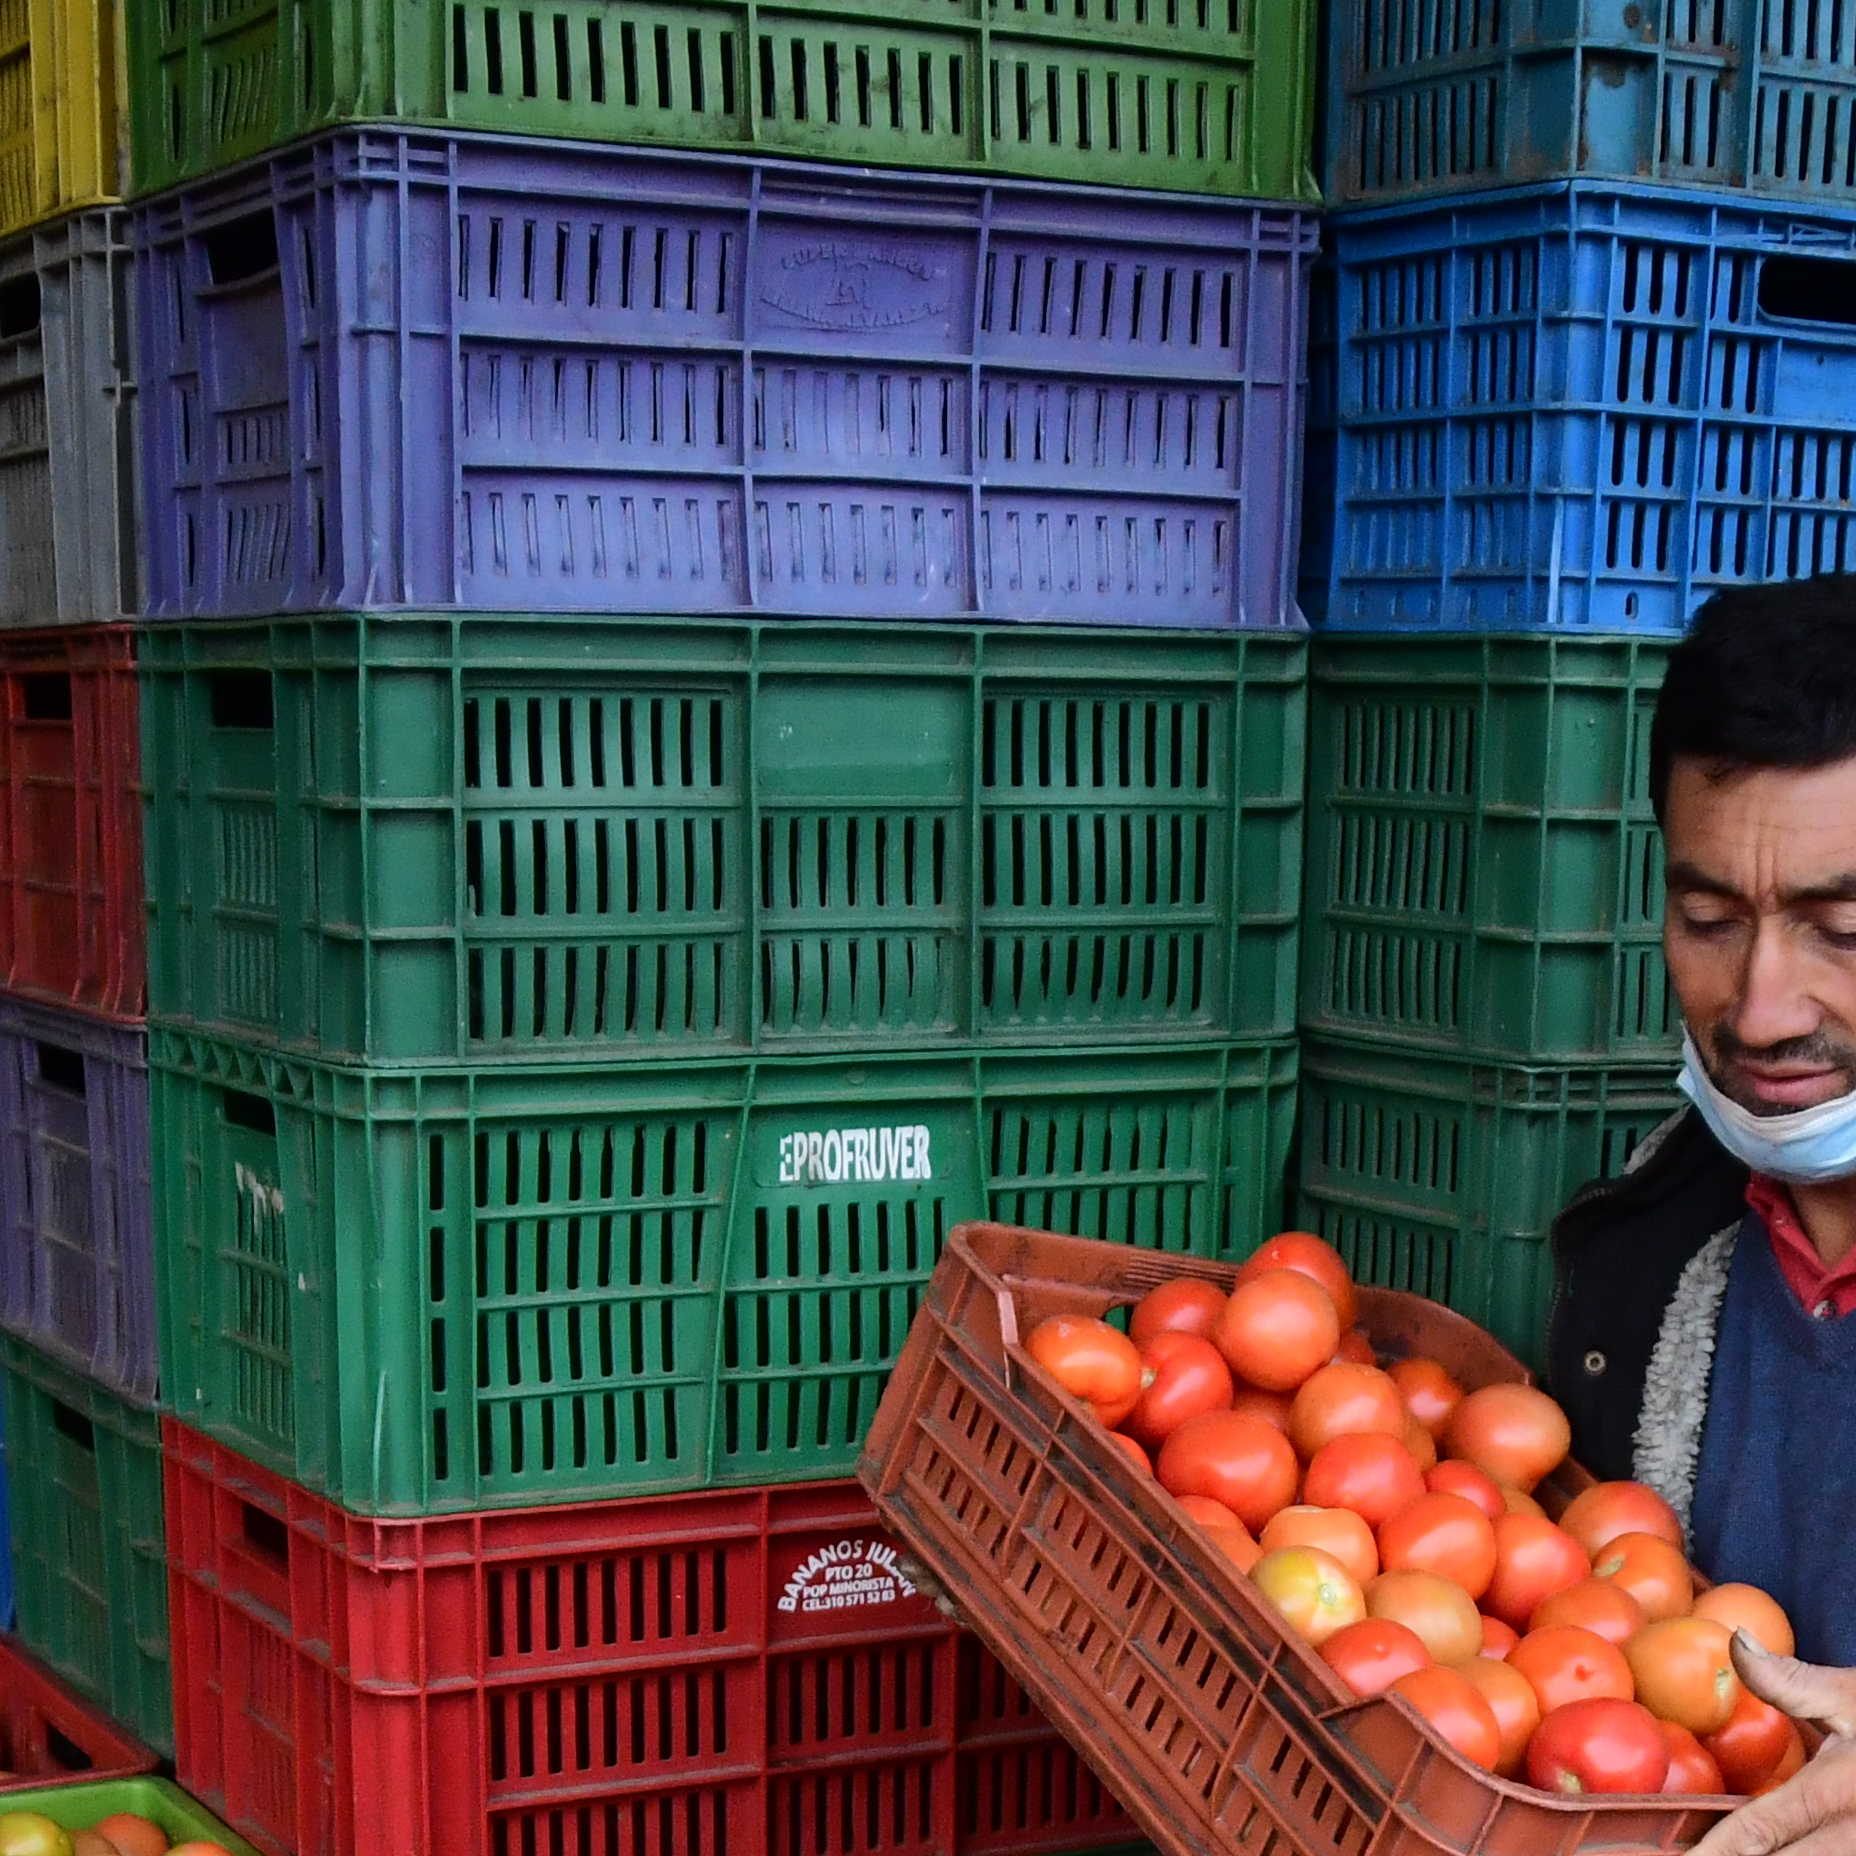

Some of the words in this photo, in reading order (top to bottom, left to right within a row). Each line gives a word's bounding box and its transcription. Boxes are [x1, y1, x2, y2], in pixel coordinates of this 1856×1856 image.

[777, 1539, 863, 1613] BANANOS
[825, 1565, 854, 1583] PTO
[855, 1563, 873, 1579] 20
[802, 1583, 828, 1600] POP
[829, 1576, 895, 1596] MINORISTA
